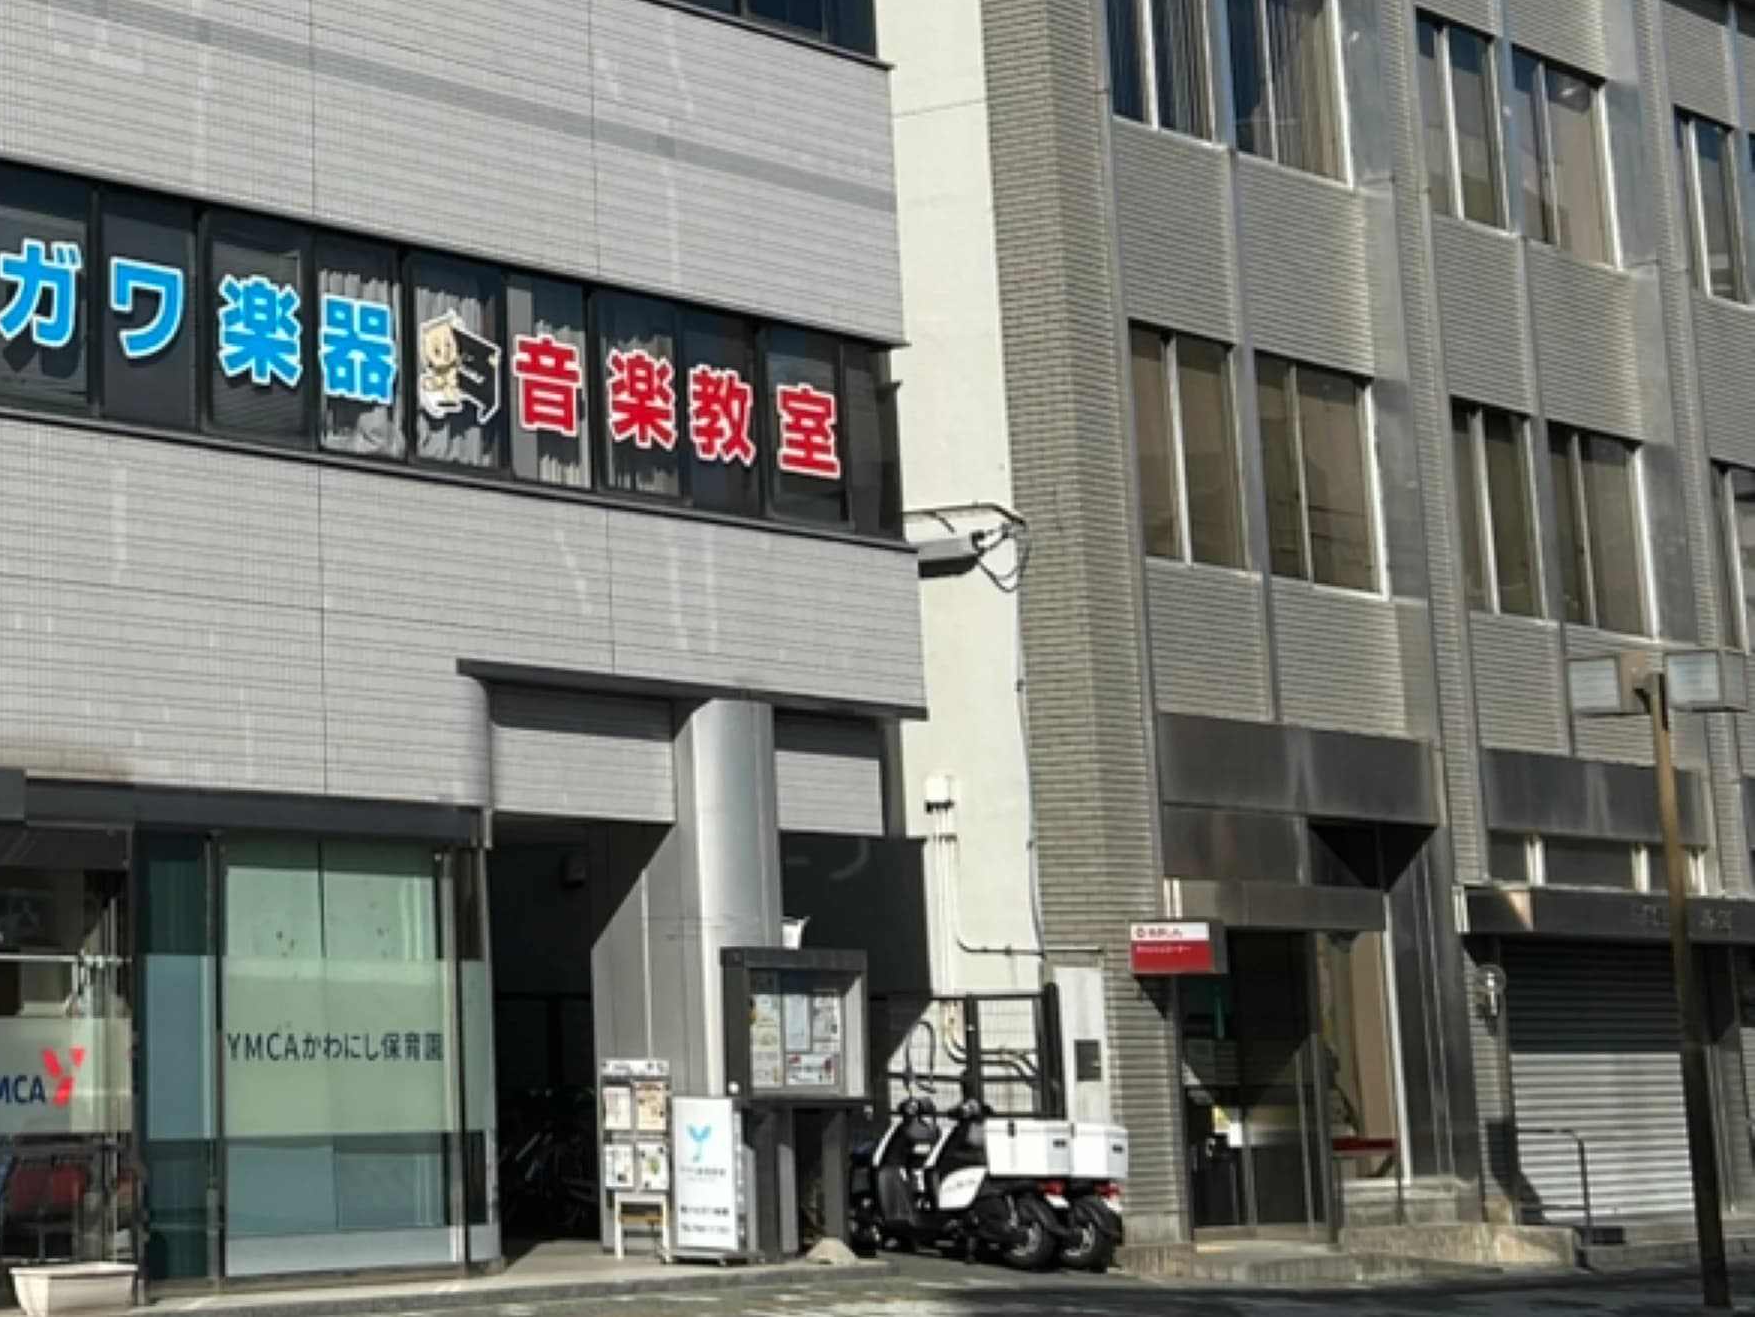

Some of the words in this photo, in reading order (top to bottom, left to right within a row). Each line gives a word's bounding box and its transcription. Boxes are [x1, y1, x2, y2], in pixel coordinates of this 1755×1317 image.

[512, 332, 843, 480] 音楽教室
[226, 1031, 444, 1062] YMCAかわにし保育園
